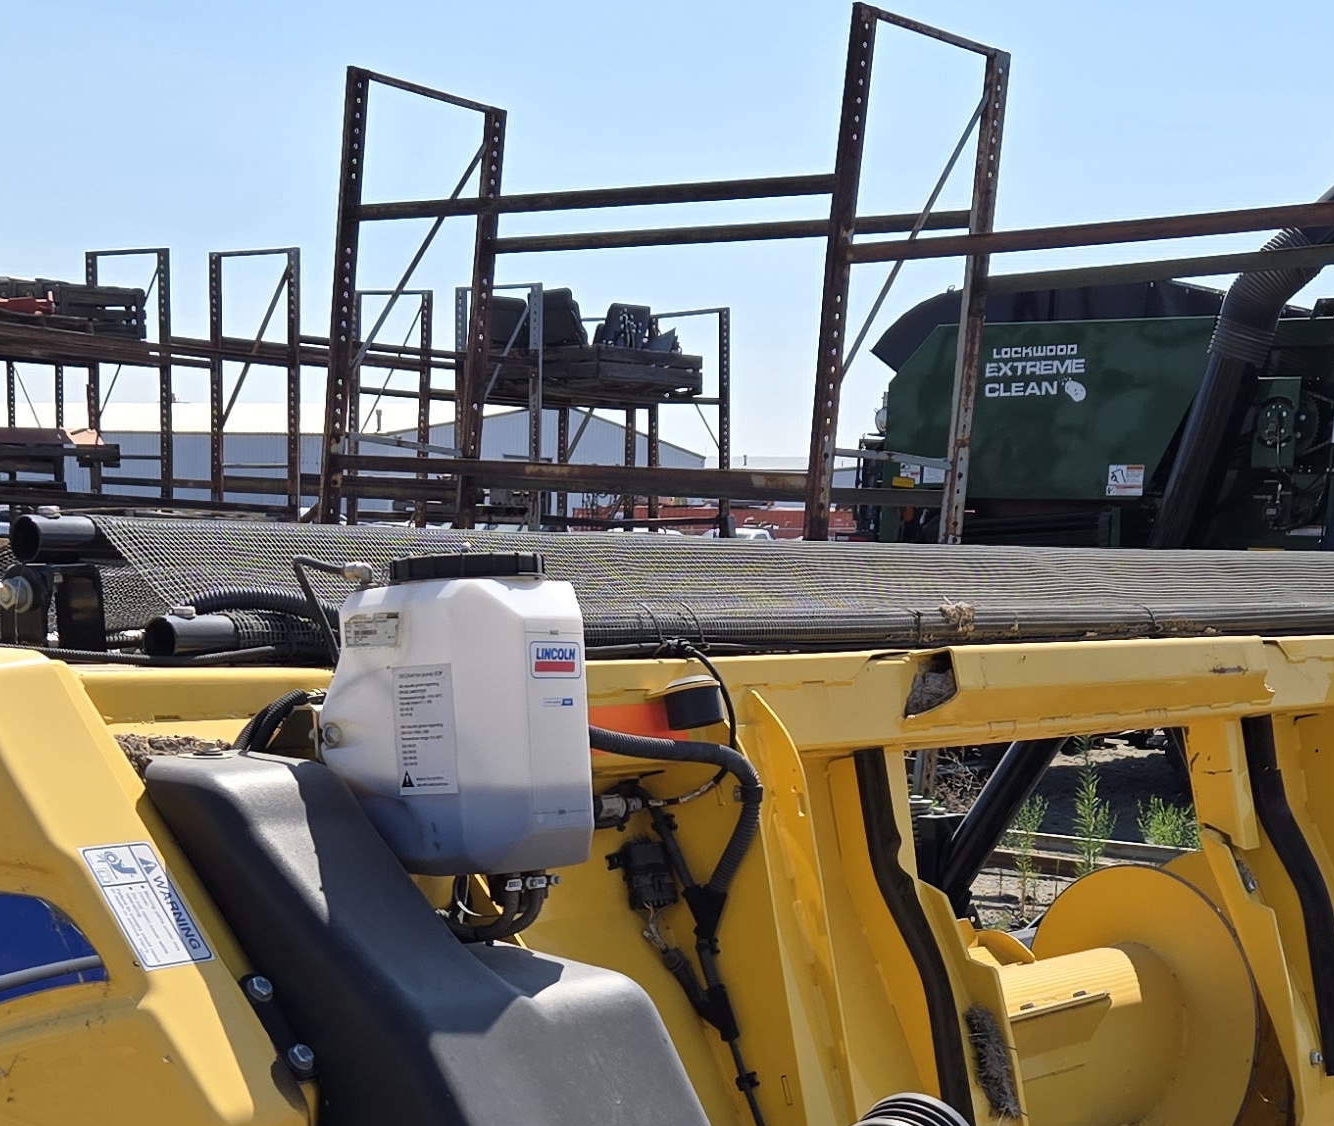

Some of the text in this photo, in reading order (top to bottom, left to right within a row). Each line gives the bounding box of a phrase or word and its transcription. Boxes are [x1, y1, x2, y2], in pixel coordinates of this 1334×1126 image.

[993, 344, 1078, 359] LOCKWOOD
[985, 358, 1085, 378] EXTREME
[985, 380, 1058, 397] CLEAN
[536, 648, 575, 660] LINCOLN
[153, 875, 201, 950] WARNING
